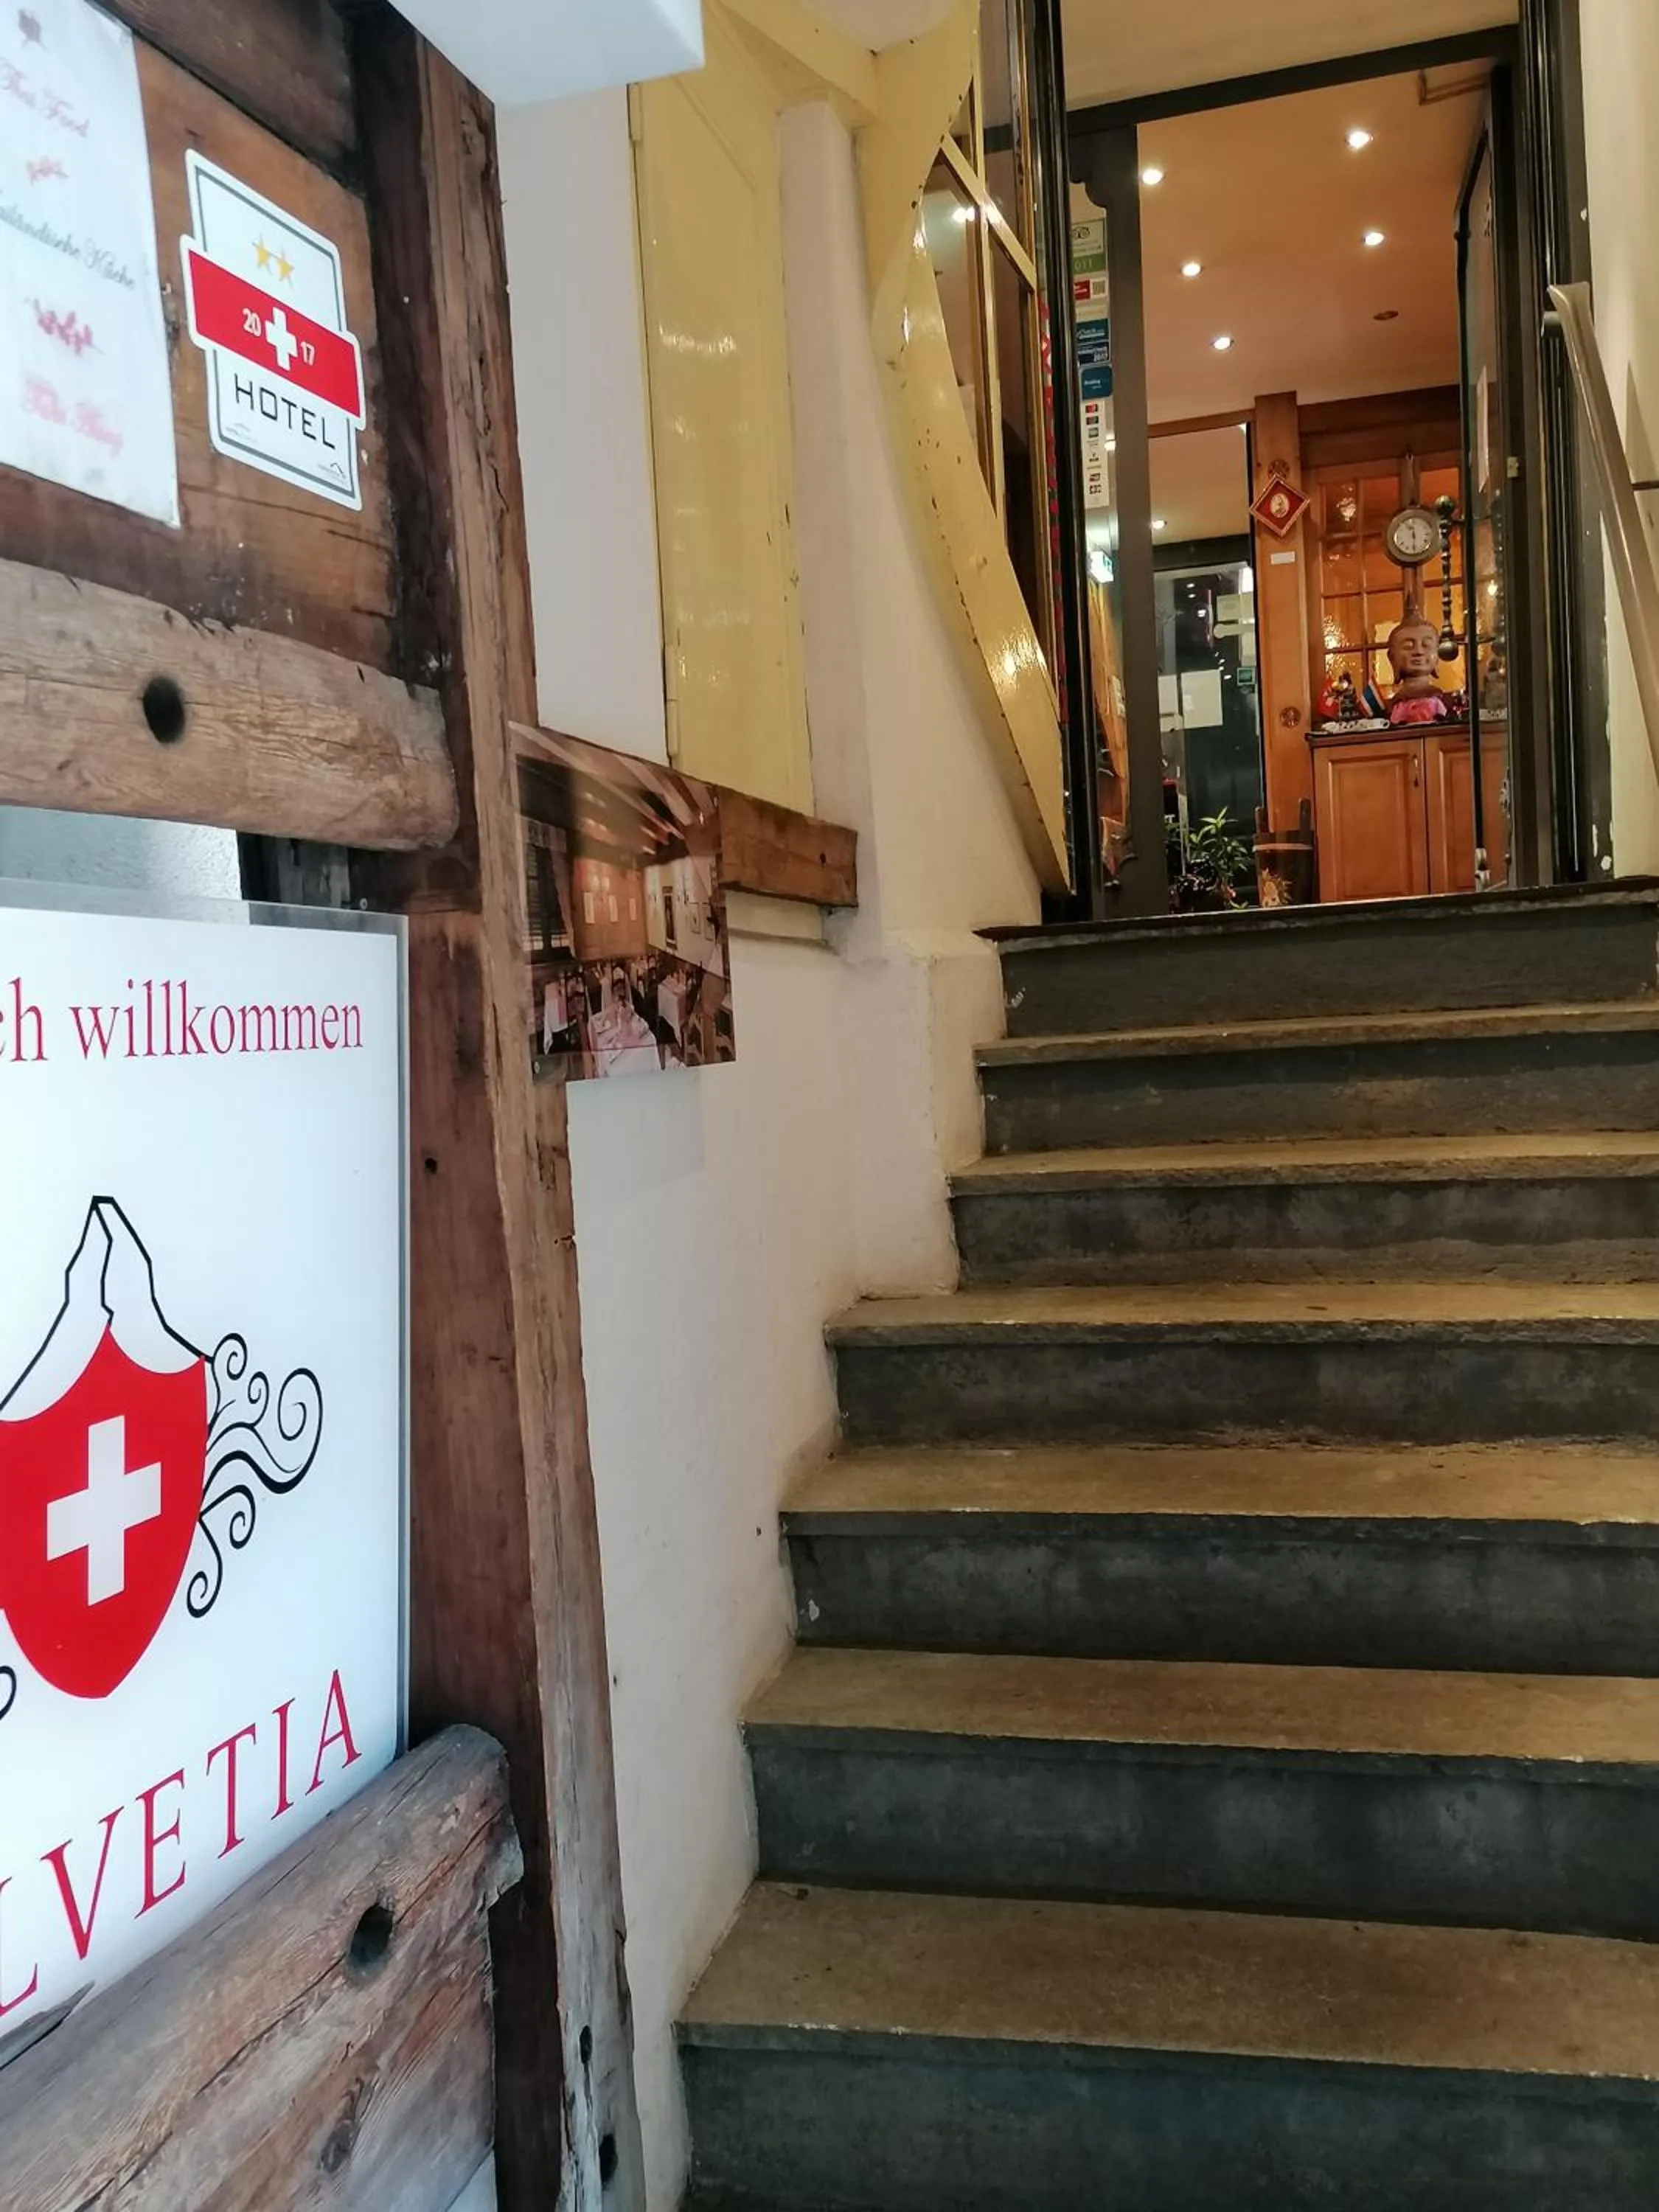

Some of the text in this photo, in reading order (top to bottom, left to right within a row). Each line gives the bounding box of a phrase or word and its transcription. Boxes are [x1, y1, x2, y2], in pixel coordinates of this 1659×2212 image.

[242, 307, 316, 366] 20 17
[234, 372, 335, 450] HOTEL
[0, 977, 364, 1062] h willkommen
